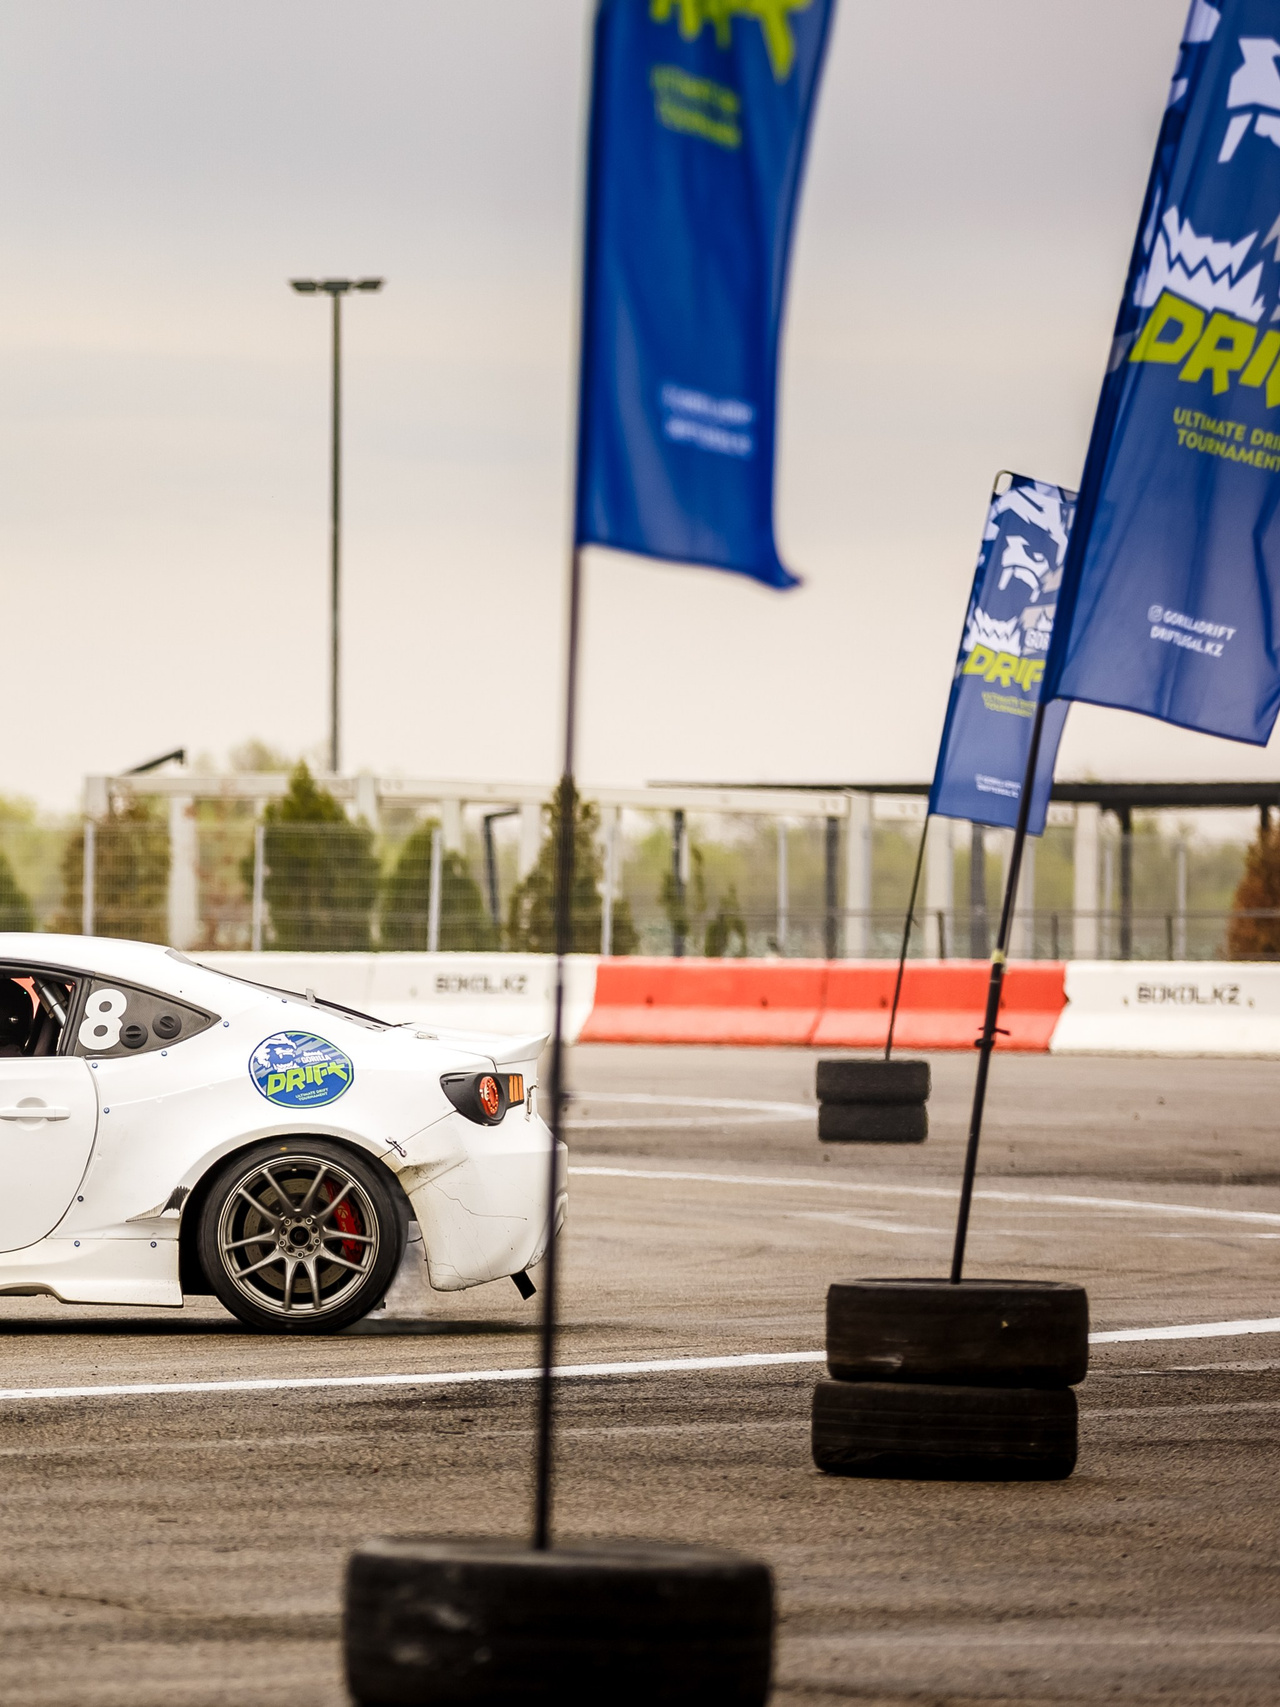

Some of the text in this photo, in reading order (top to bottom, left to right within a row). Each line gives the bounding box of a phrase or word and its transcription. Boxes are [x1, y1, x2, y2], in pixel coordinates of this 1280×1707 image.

[1173, 407, 1280, 452] ULTIMATE DRI
[1178, 429, 1280, 473] TOURNAMENT
[79, 988, 128, 1051] 8
[301, 1054, 331, 1063] GORILLA
[267, 1062, 348, 1096] DRIFT
[295, 1090, 316, 1099] ULTIMATE
